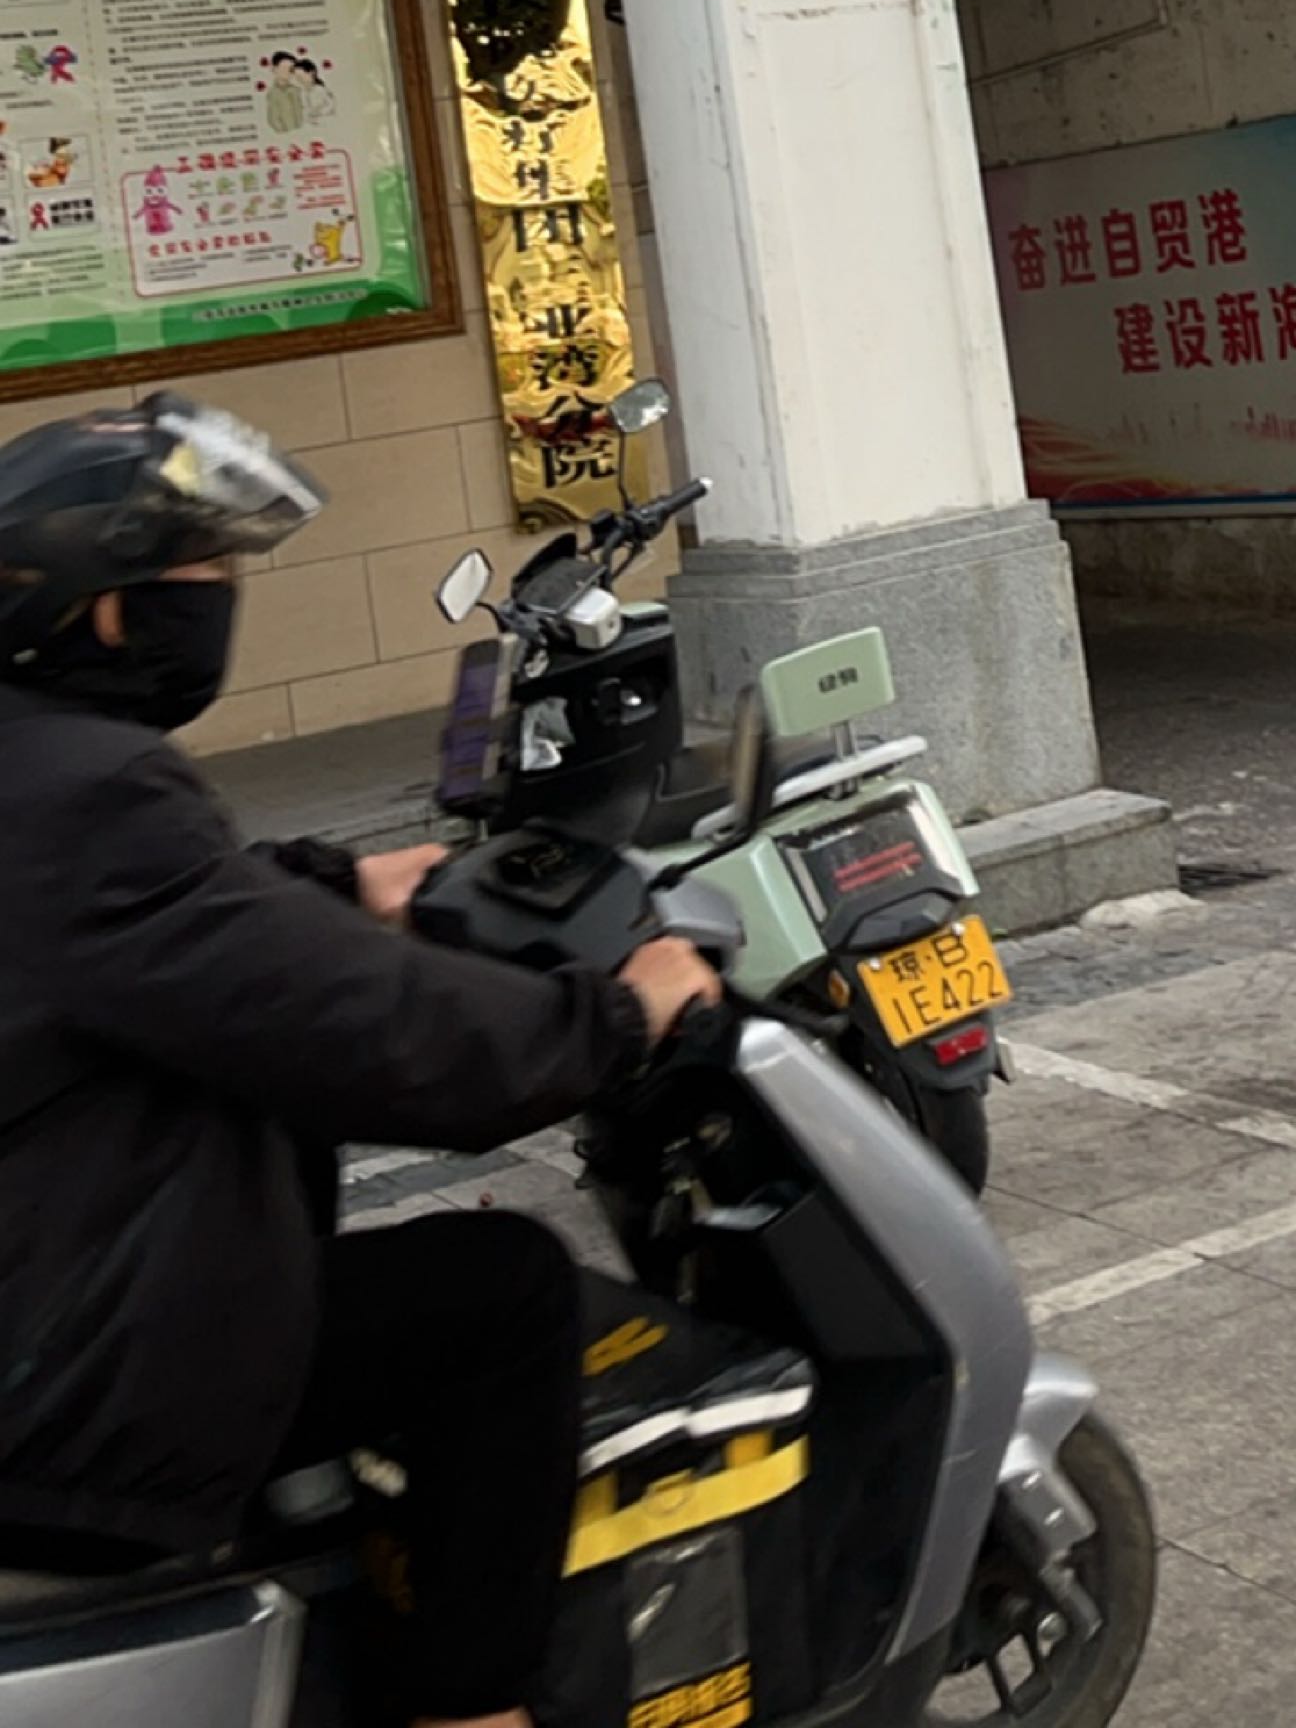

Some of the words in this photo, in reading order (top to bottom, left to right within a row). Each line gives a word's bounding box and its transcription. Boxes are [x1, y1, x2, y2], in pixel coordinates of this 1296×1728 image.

[1008, 188, 1248, 292] 奋进自贸港
[894, 962, 1003, 1034] 1E422
